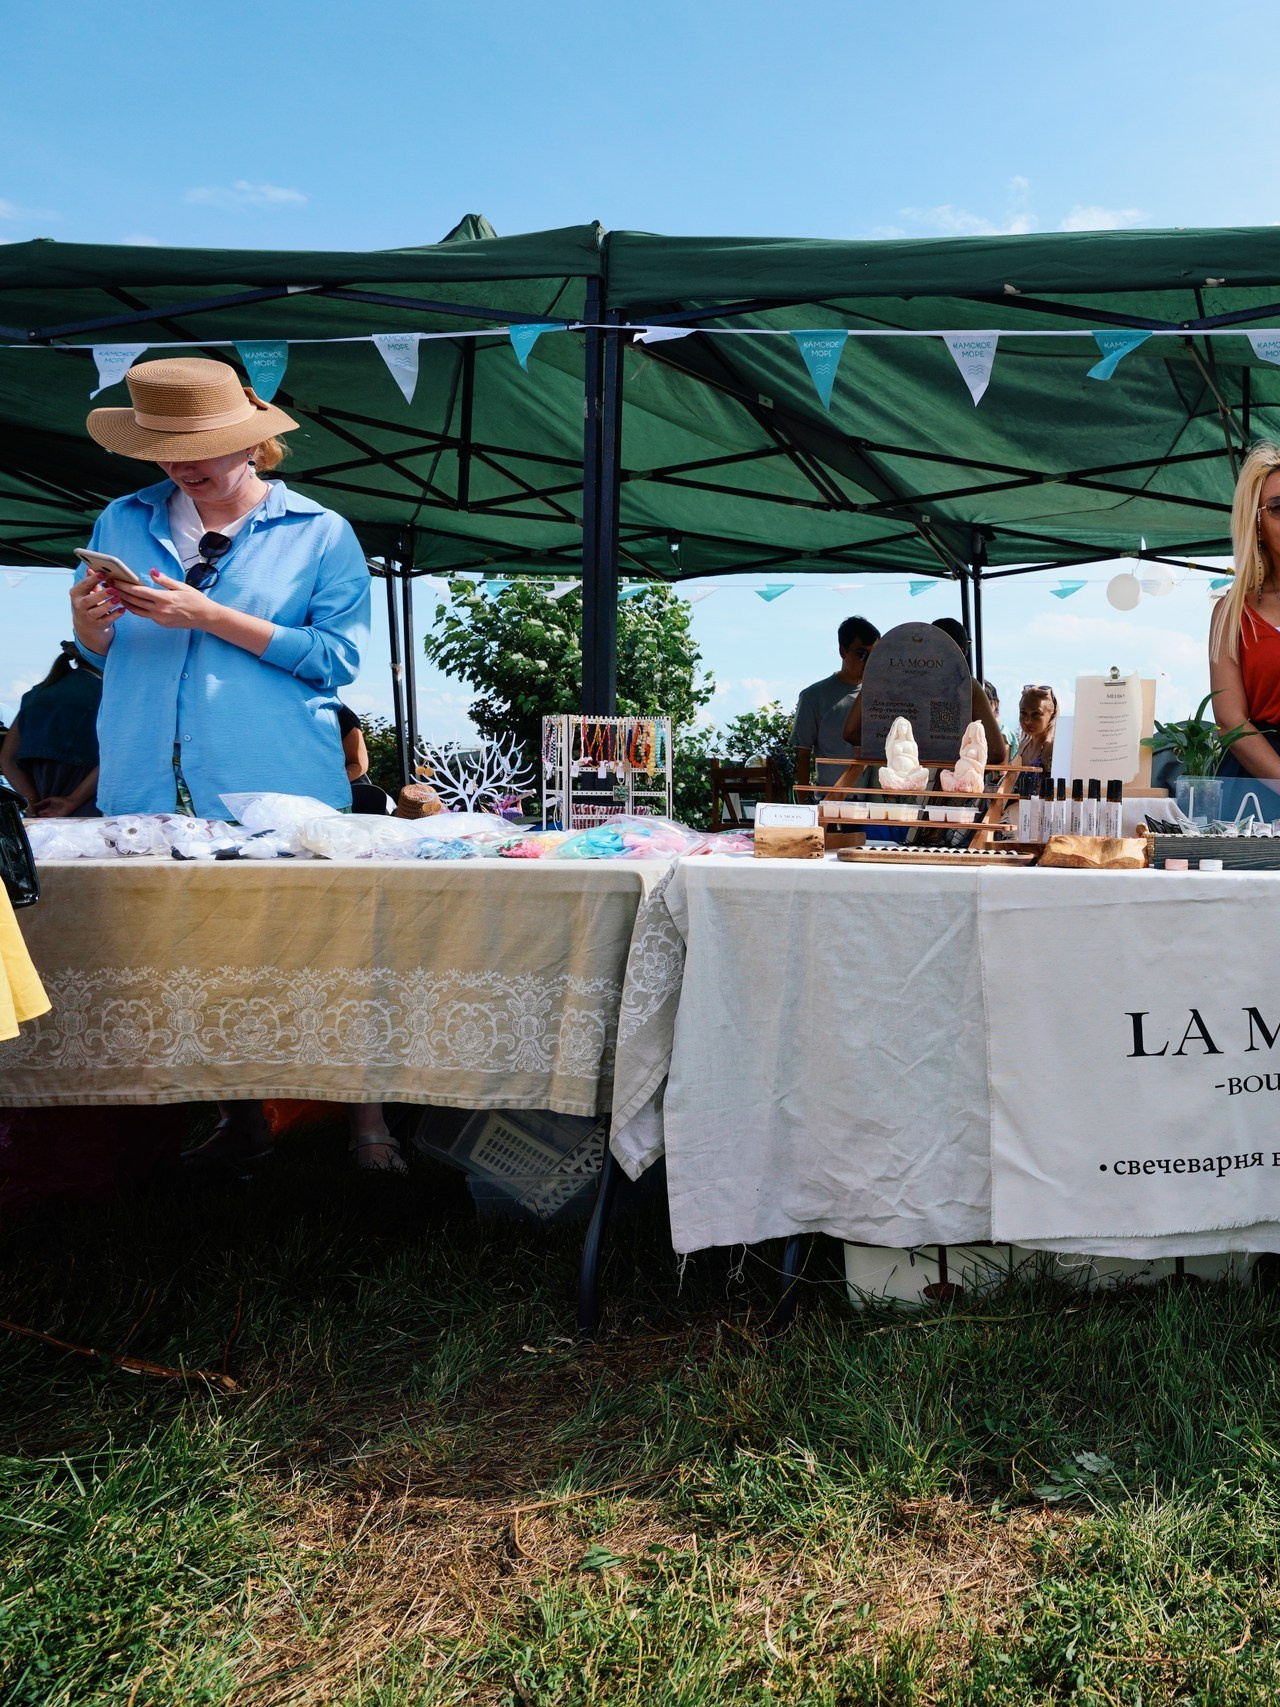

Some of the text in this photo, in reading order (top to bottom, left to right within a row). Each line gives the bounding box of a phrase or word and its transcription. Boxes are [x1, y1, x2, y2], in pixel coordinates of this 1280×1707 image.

[387, 343, 410, 351] МОРЕ
[803, 340, 839, 349] КАМСКОЕ
[952, 341, 992, 349] КАМСКОЕ
[811, 349, 832, 357] МОРЕ
[961, 350, 985, 358] МОРЕ
[253, 359, 277, 367] МОРЕ
[890, 658, 944, 669] LA MOON
[1124, 1008, 1225, 1057] LA
[1113, 1151, 1264, 1178] свечеварня
